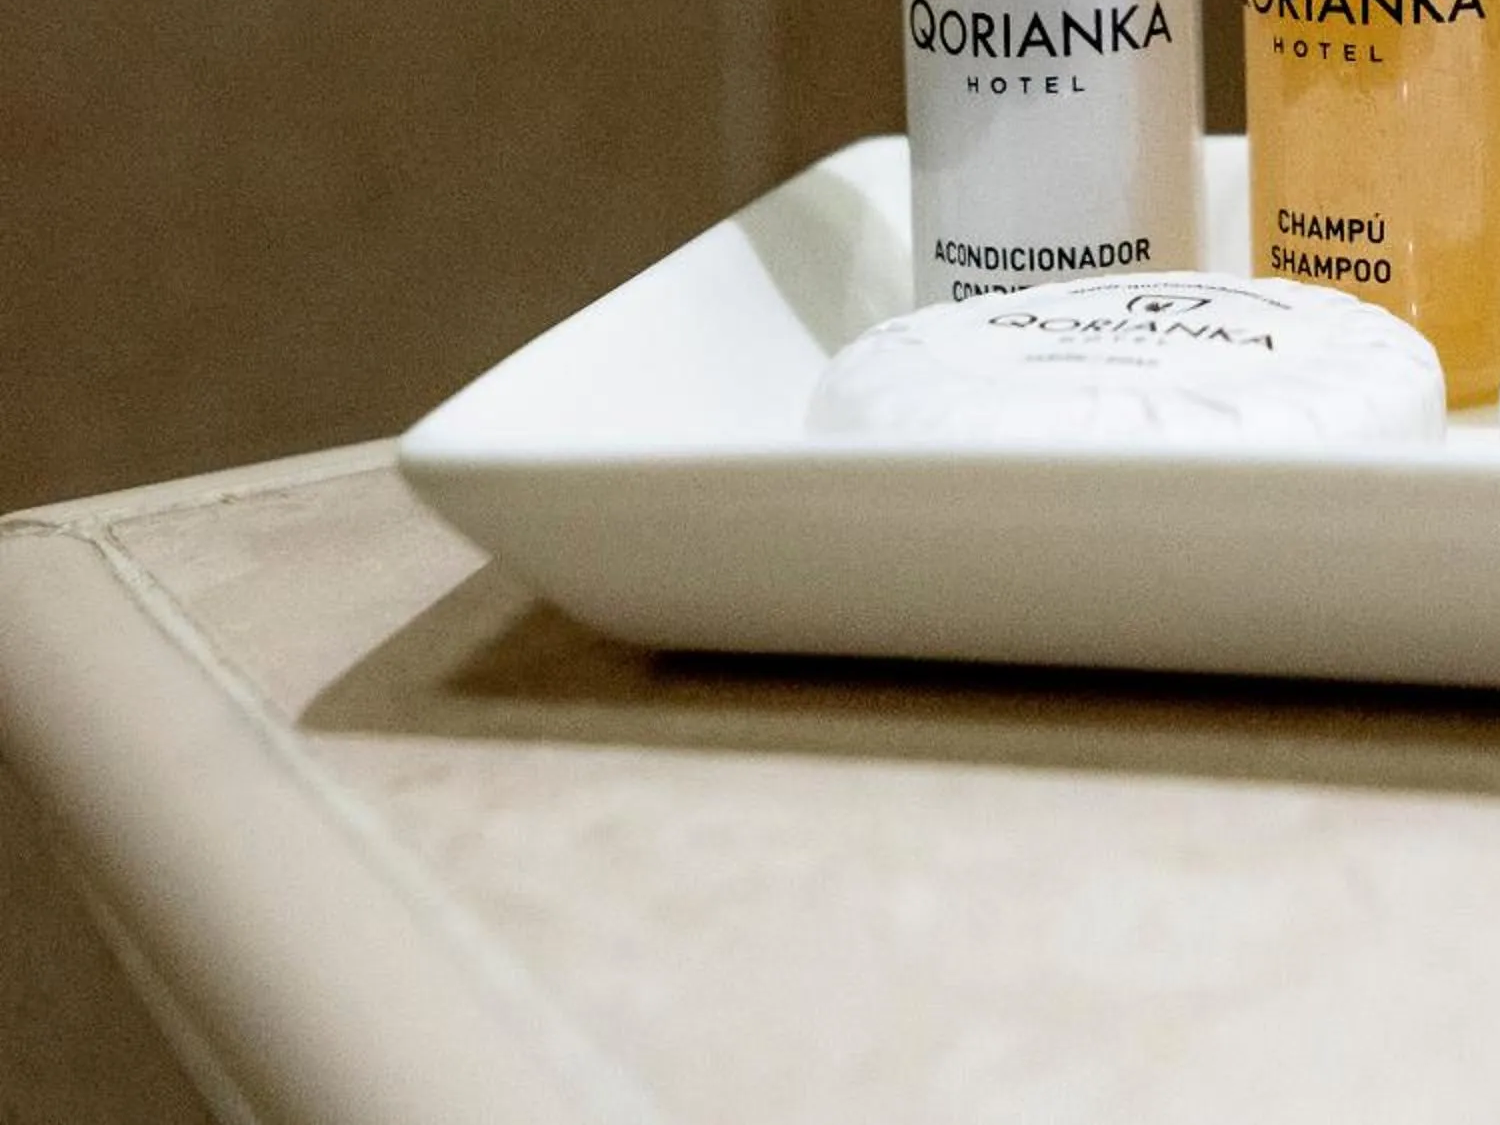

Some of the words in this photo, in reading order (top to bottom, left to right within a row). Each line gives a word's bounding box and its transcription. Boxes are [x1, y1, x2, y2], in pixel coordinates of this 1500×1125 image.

[1273, 37, 1384, 63] HOTEL
[966, 76, 1086, 94] HOTEL
[1277, 209, 1386, 244] CHAMPÚ
[934, 237, 1152, 272] ACONDICIONADOR
[1271, 245, 1392, 284] SHAMPOO
[988, 312, 1275, 351] QORIANKA
